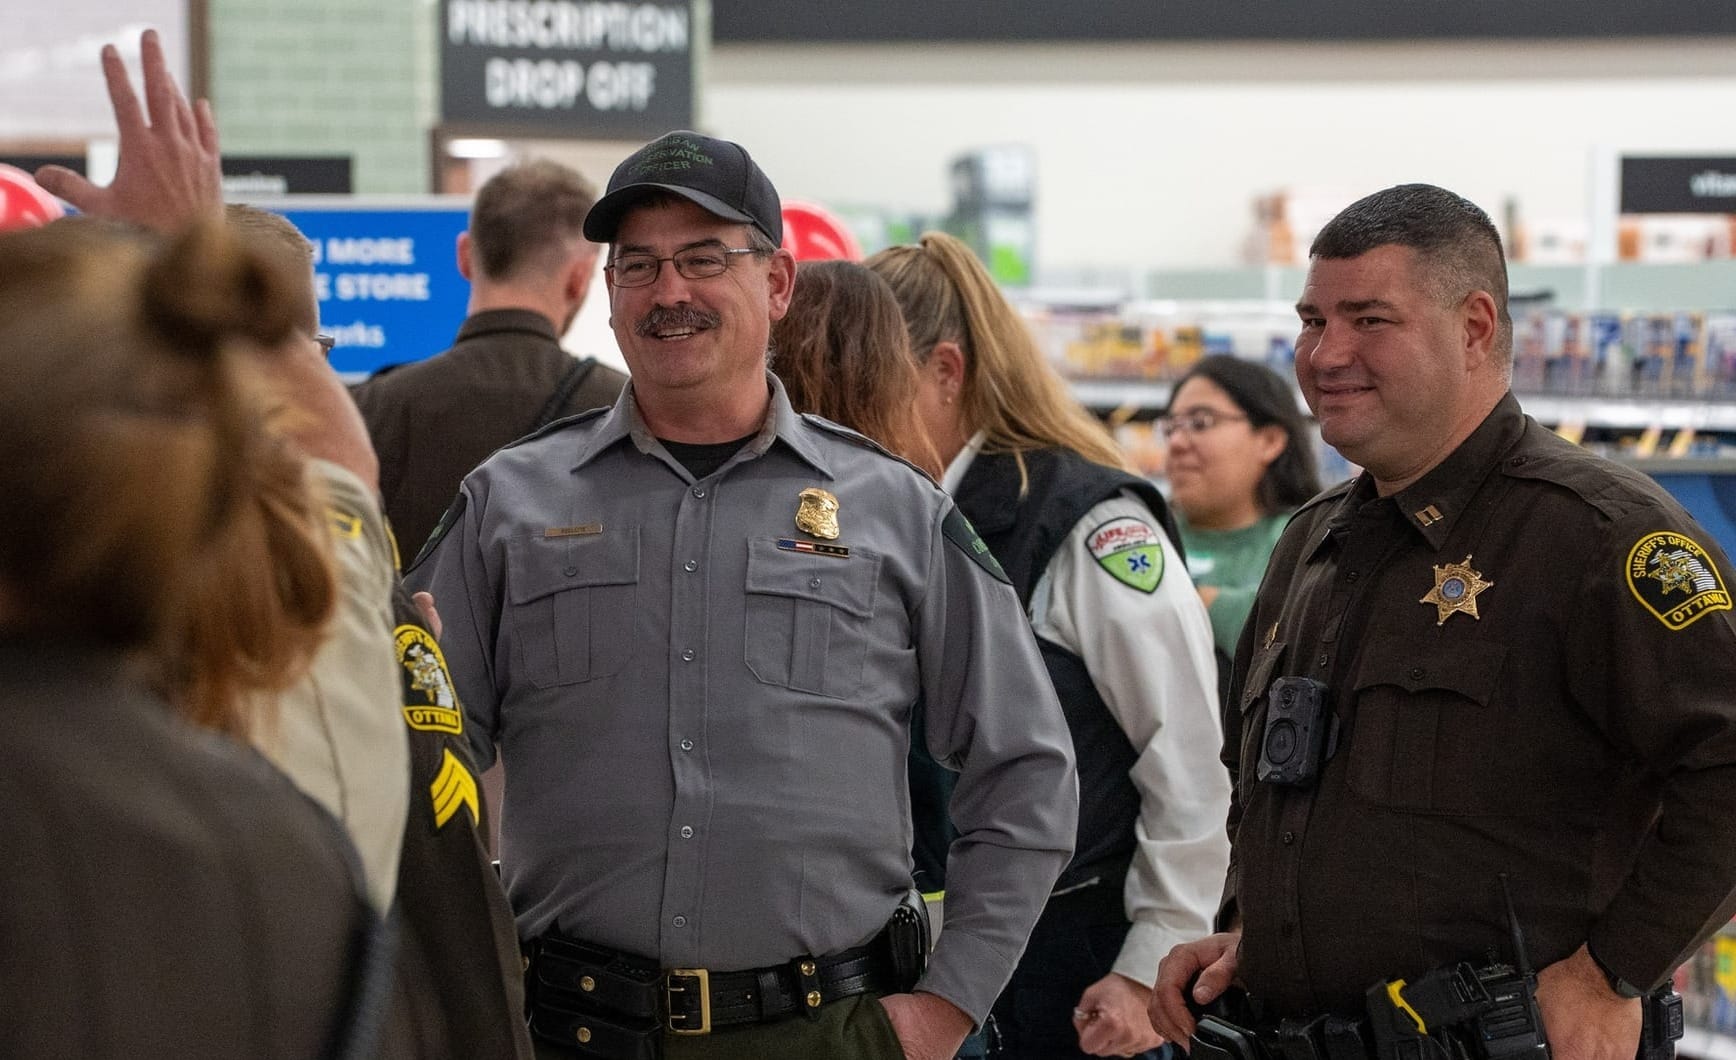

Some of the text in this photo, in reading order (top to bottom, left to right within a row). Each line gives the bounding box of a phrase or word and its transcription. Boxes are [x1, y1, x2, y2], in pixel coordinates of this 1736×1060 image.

[448, 0, 689, 50] PRESCRIPTION
[485, 57, 657, 110] DROP OFF
[326, 237, 415, 266] MORE
[335, 272, 430, 301] STORE
[1632, 536, 1702, 579] SHERIFF'S OFFICE
[1671, 593, 1728, 623] OTTAWA
